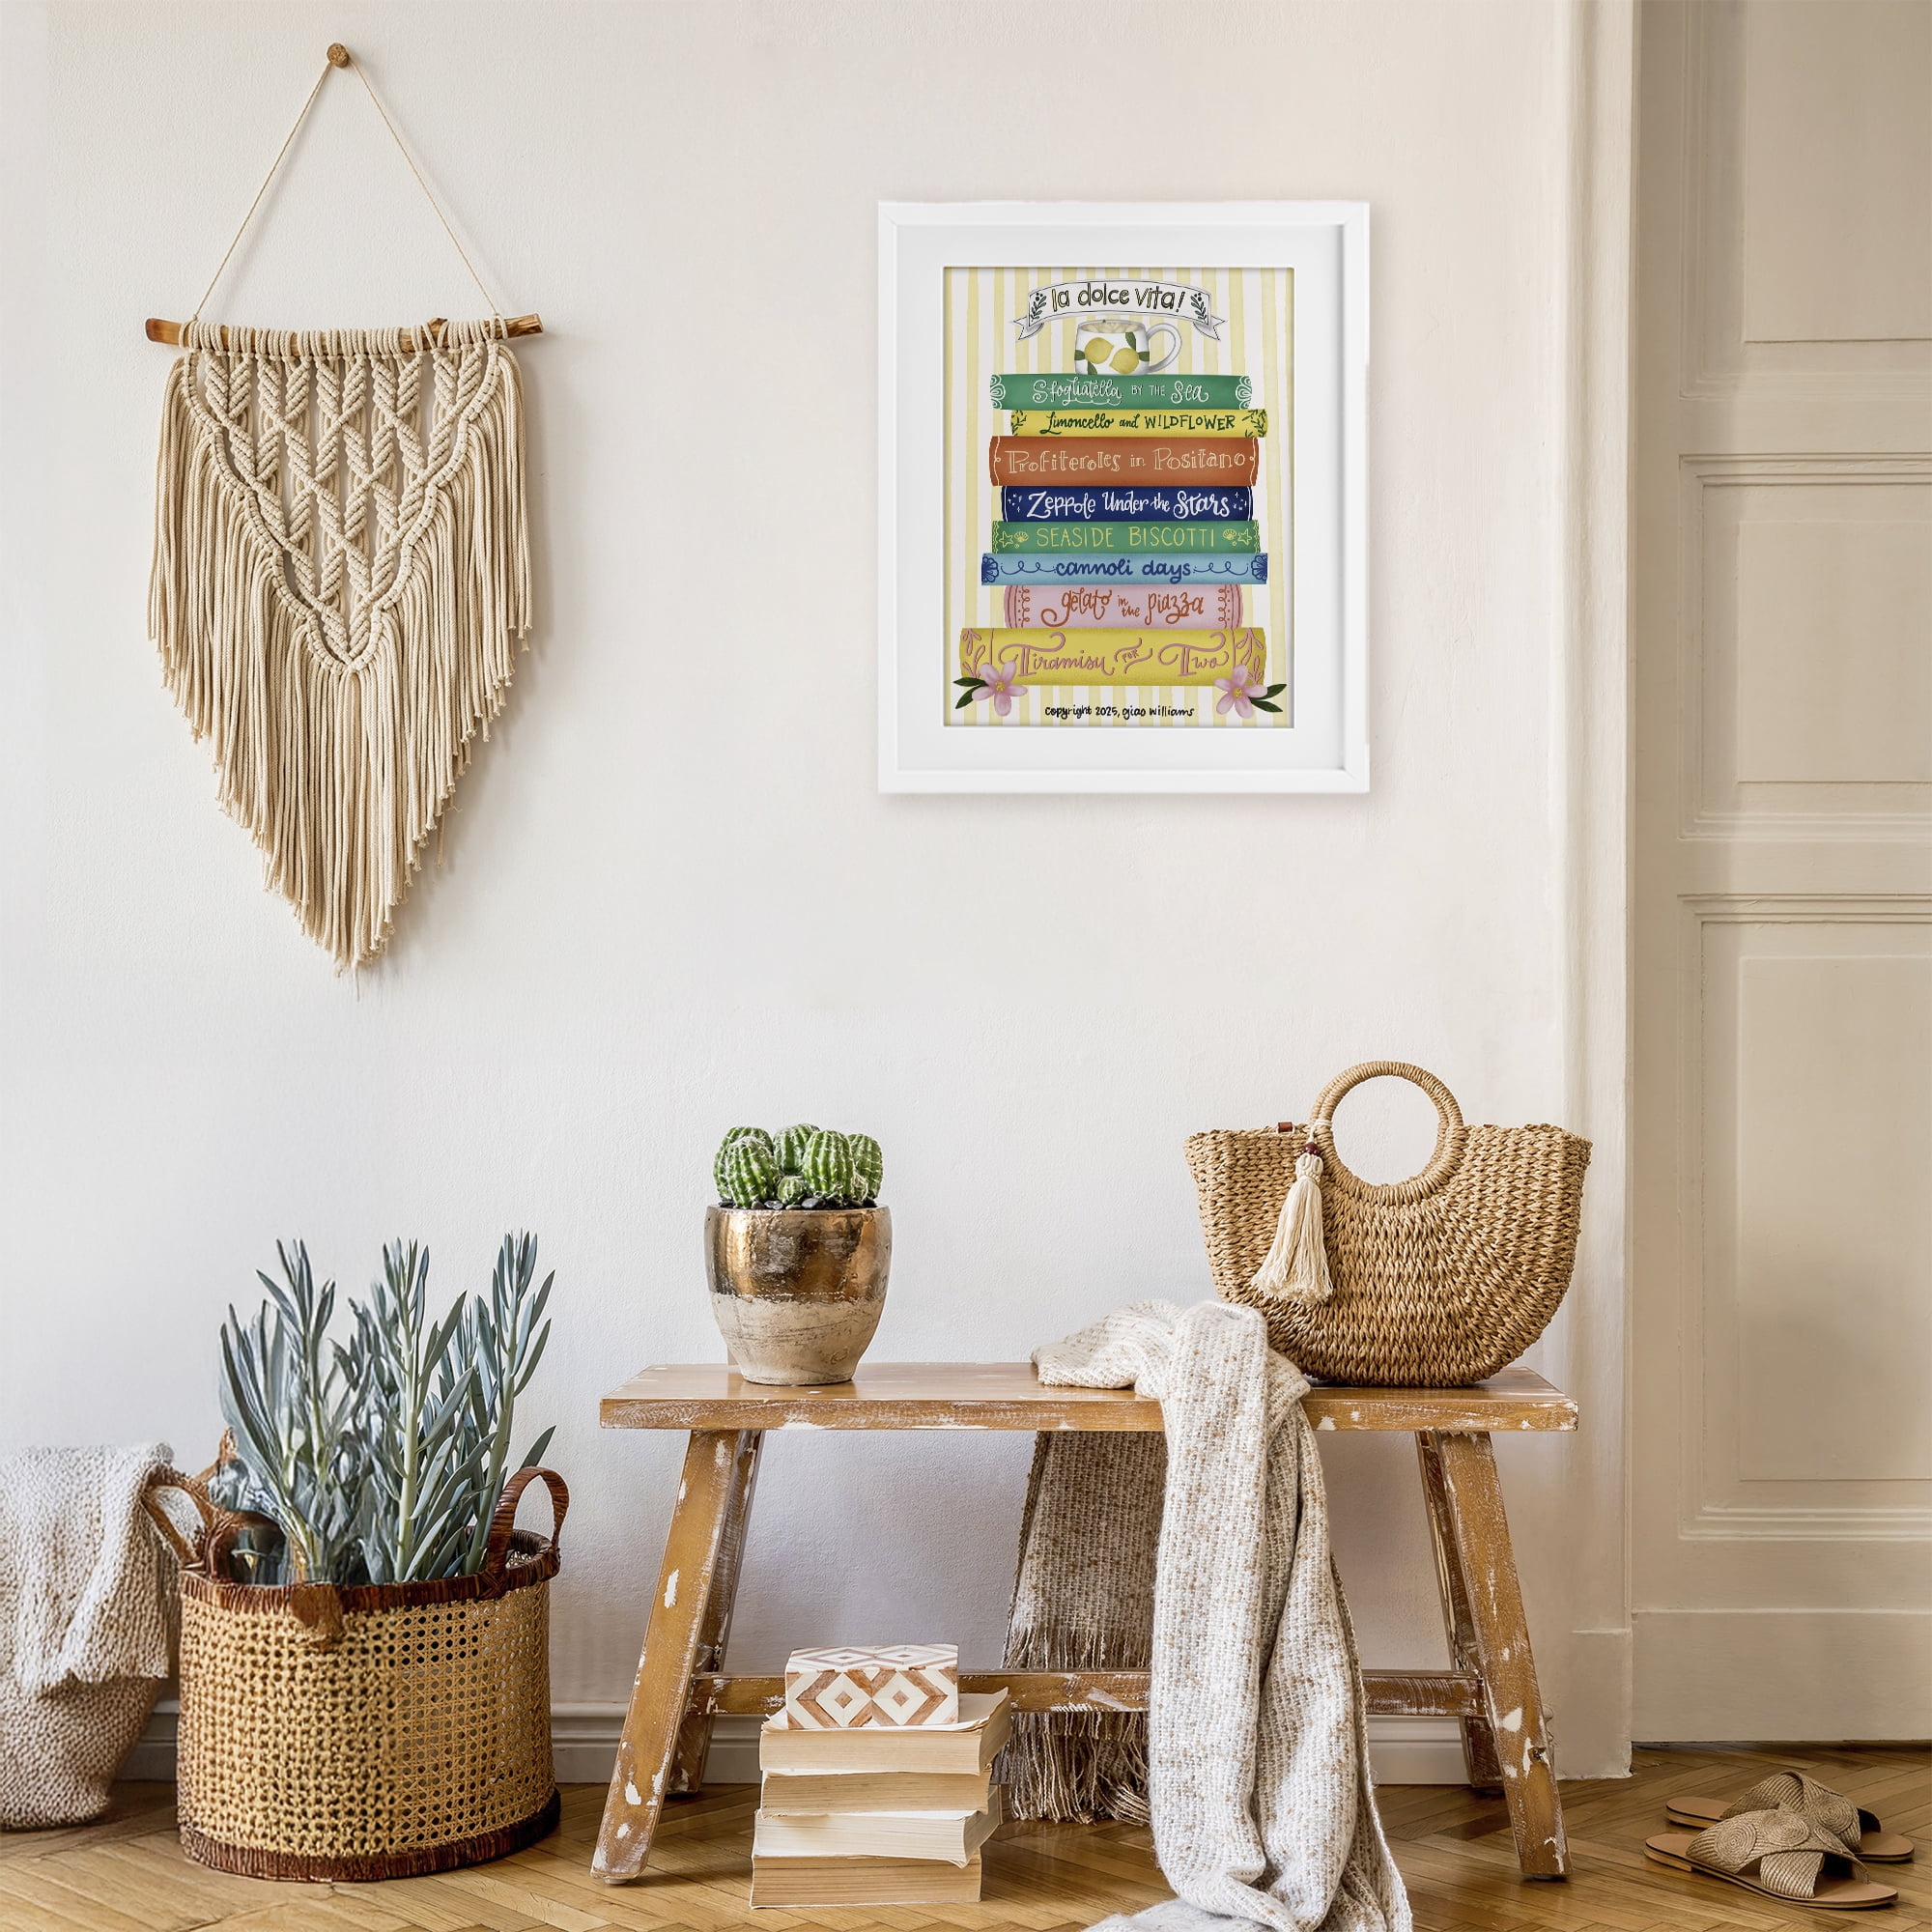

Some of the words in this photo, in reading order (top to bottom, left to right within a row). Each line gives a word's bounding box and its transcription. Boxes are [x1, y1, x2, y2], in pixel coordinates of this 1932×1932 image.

[1052, 288, 1069, 311] la
[1078, 282, 1129, 308] dolce
[1135, 286, 1185, 312] vita!
[1033, 377, 1122, 406] Sfogliatella
[1132, 385, 1143, 395] BY
[1151, 385, 1165, 396] THE
[1171, 378, 1208, 404] Sea
[1039, 413, 1114, 435] Limoncello
[1120, 413, 1140, 429] and
[1145, 415, 1236, 430] WILDFLOWER
[1005, 450, 1121, 474] Profiteroles
[1130, 454, 1146, 467] in
[1152, 448, 1245, 469] Positano
[1026, 492, 1095, 519] Zeppole
[1102, 492, 1150, 514] Under
[1151, 495, 1170, 512] the
[1173, 491, 1230, 519] Stars
[1037, 527, 1114, 548] SEASIDE
[1128, 526, 1214, 547] BISCOTTI
[1055, 558, 1133, 576] cannoli
[1142, 560, 1191, 583] days
[1041, 587, 1112, 627] gelato
[1118, 595, 1127, 608] in
[1122, 606, 1140, 617] the
[1145, 591, 1204, 625] piazza
[998, 632, 1115, 676] Tiramisu
[1158, 632, 1230, 676] Two
[1095, 706, 1120, 719] 2025,
